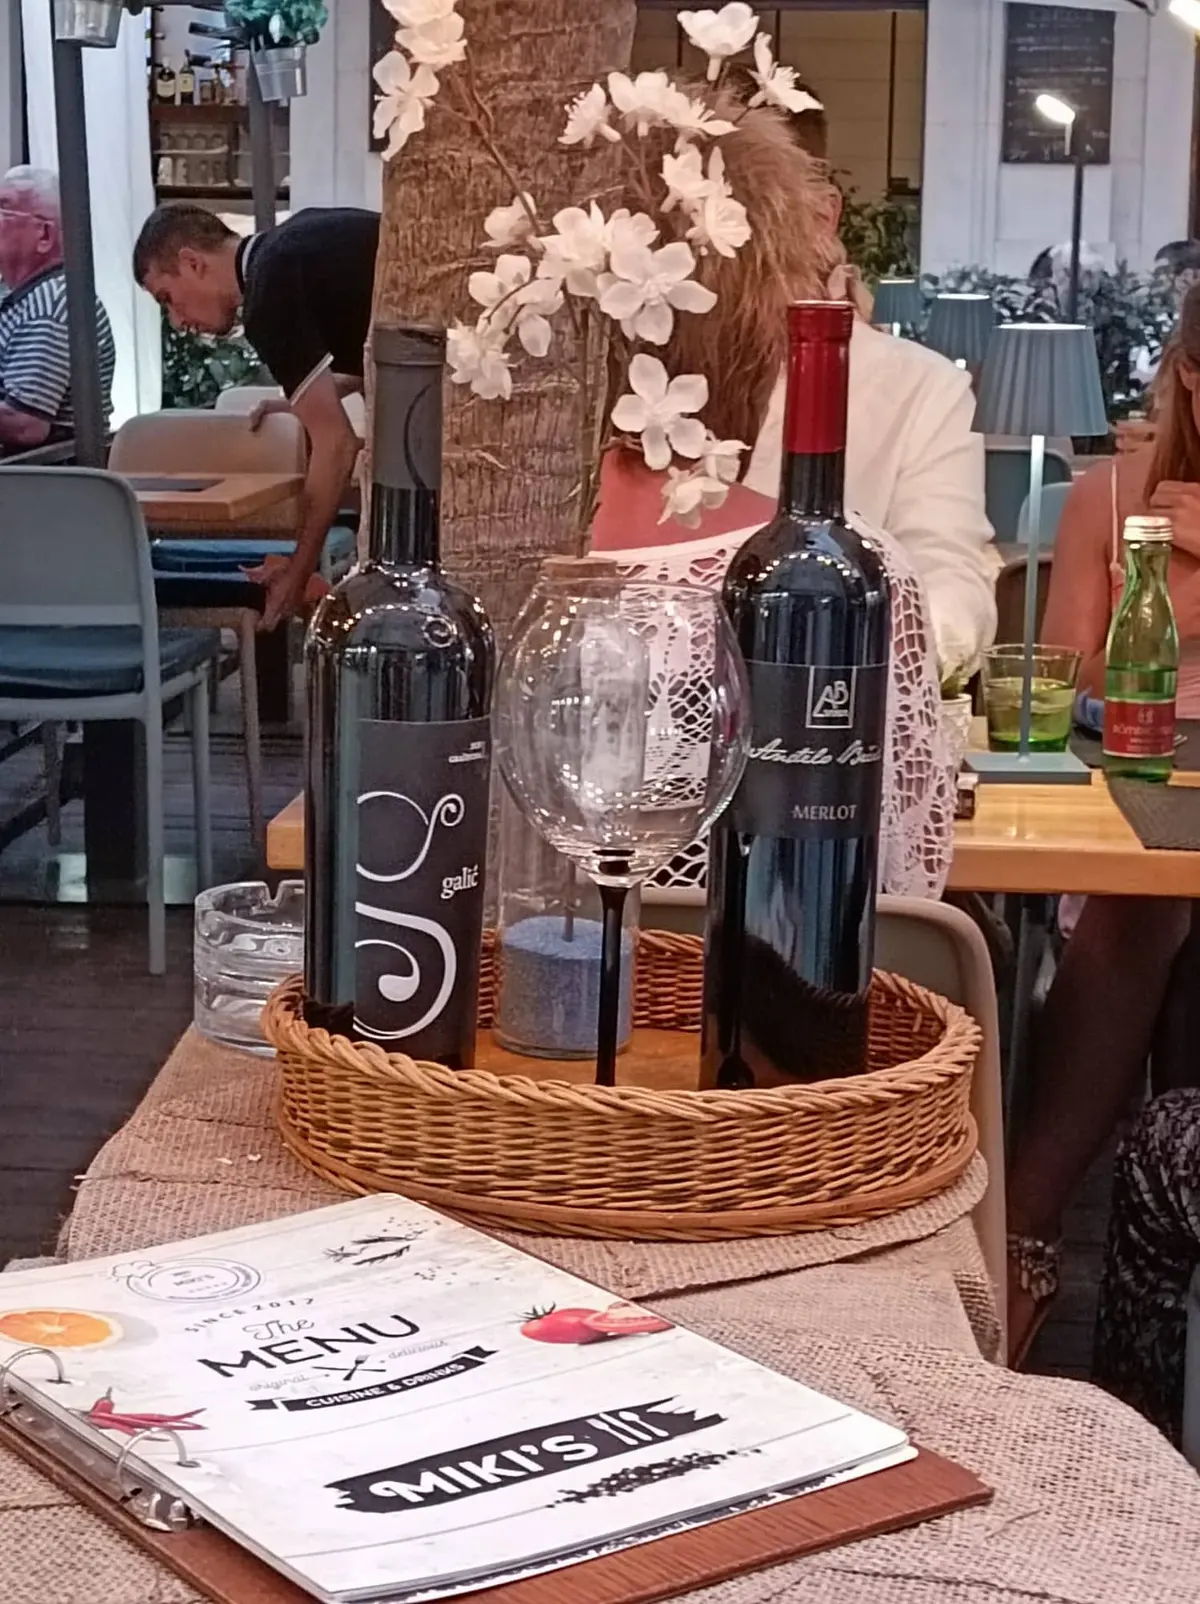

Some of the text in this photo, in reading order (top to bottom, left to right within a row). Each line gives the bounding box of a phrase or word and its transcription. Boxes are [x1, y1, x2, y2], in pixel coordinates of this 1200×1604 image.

[792, 804, 857, 820] MERLOT
[440, 865, 479, 899] galić
[184, 1297, 314, 1333] SINCE 2017
[242, 1318, 315, 1341] The
[197, 1314, 421, 1378] MENU
[305, 1363, 468, 1408] CUISINE & DRINKS
[368, 1433, 600, 1505] MIKI'S
